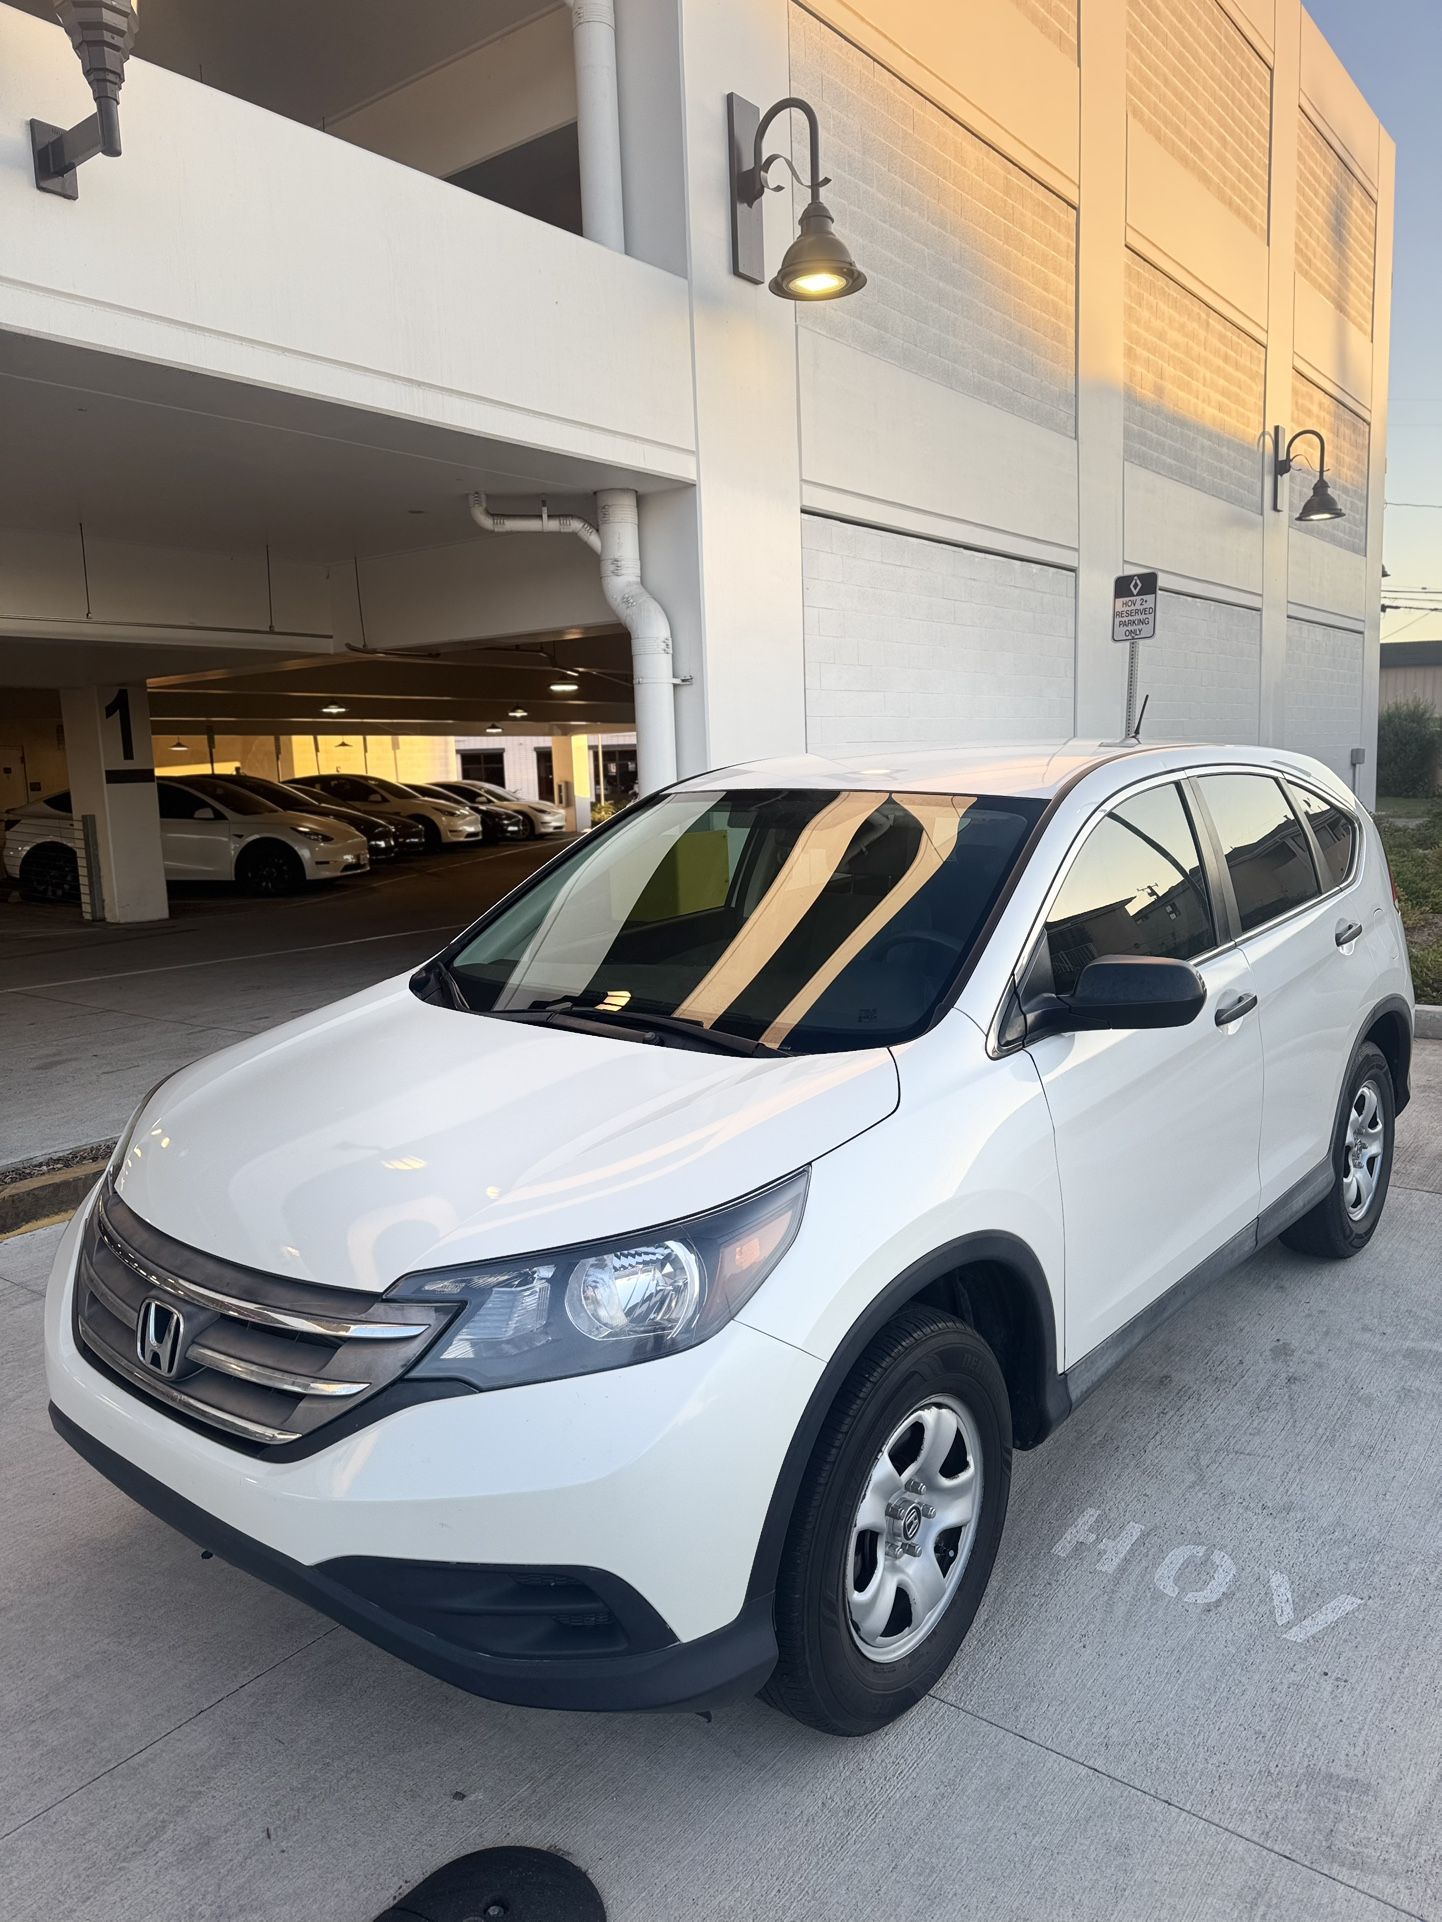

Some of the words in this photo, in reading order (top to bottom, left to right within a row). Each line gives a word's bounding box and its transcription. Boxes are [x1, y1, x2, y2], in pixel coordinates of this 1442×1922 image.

[1122, 599, 1138, 608] HOV
[1140, 598, 1148, 606] 2+
[1115, 607, 1154, 619] RESERVED
[1118, 617, 1150, 628] PARKING
[1124, 628, 1143, 637] ONLY
[105, 688, 135, 760] 1
[1051, 1506, 1364, 1643] HOV
